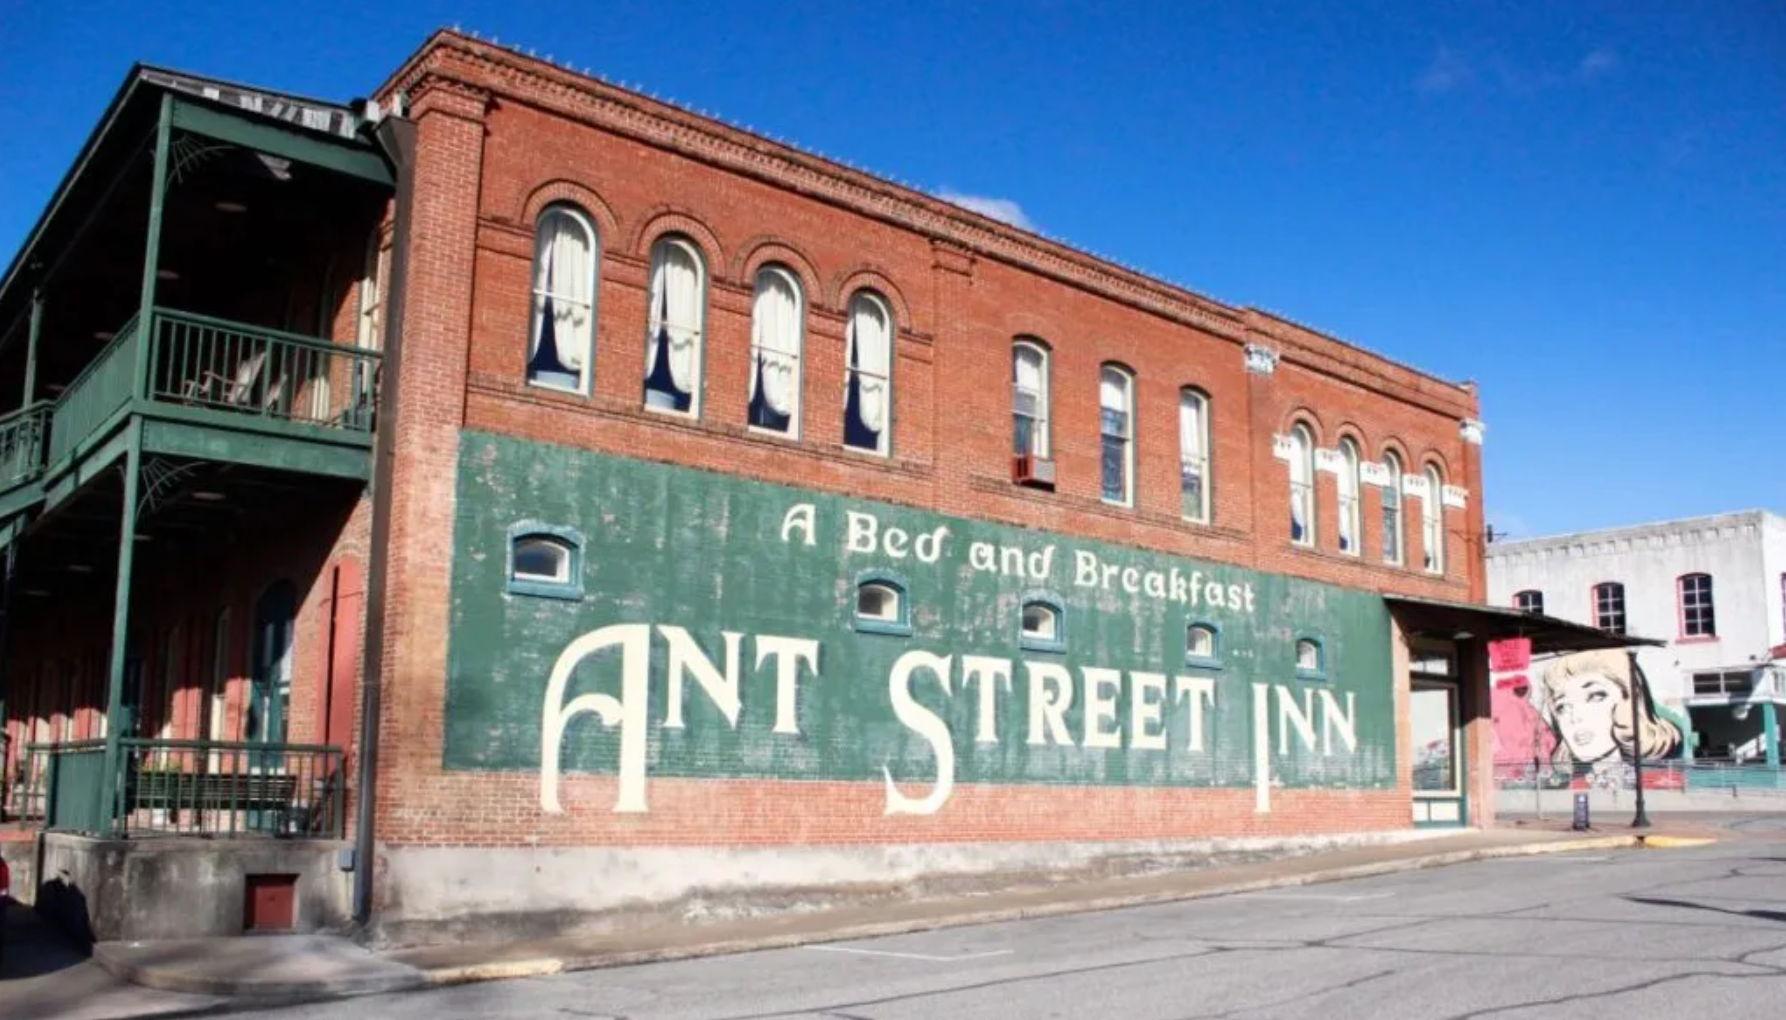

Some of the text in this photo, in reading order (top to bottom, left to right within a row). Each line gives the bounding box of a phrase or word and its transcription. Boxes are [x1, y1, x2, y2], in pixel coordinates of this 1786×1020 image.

[782, 503, 1255, 612] A Bed and Breakfast
[541, 623, 1357, 814] ANT STREET INN
